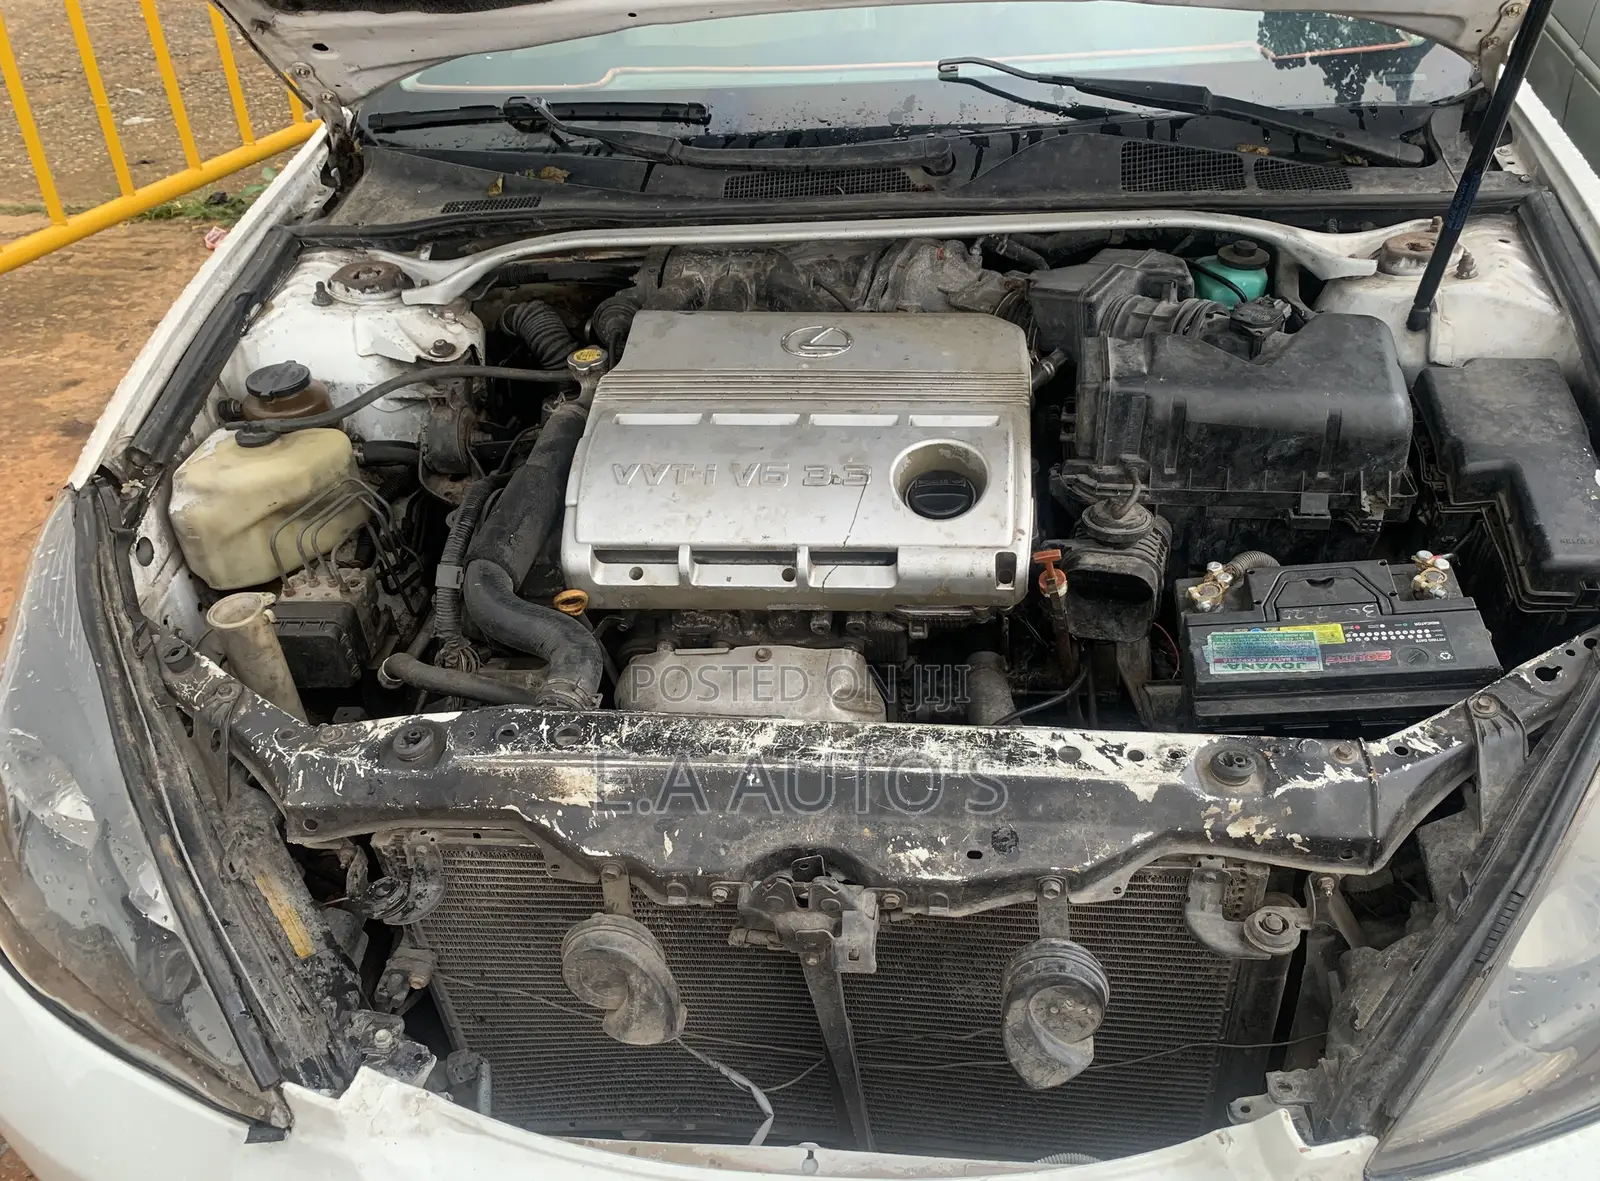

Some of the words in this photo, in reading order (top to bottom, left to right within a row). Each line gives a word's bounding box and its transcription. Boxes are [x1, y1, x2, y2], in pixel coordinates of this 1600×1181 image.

[730, 462, 790, 488] V6
[802, 464, 873, 487] 3.3
[1226, 662, 1307, 670] JOVANA
